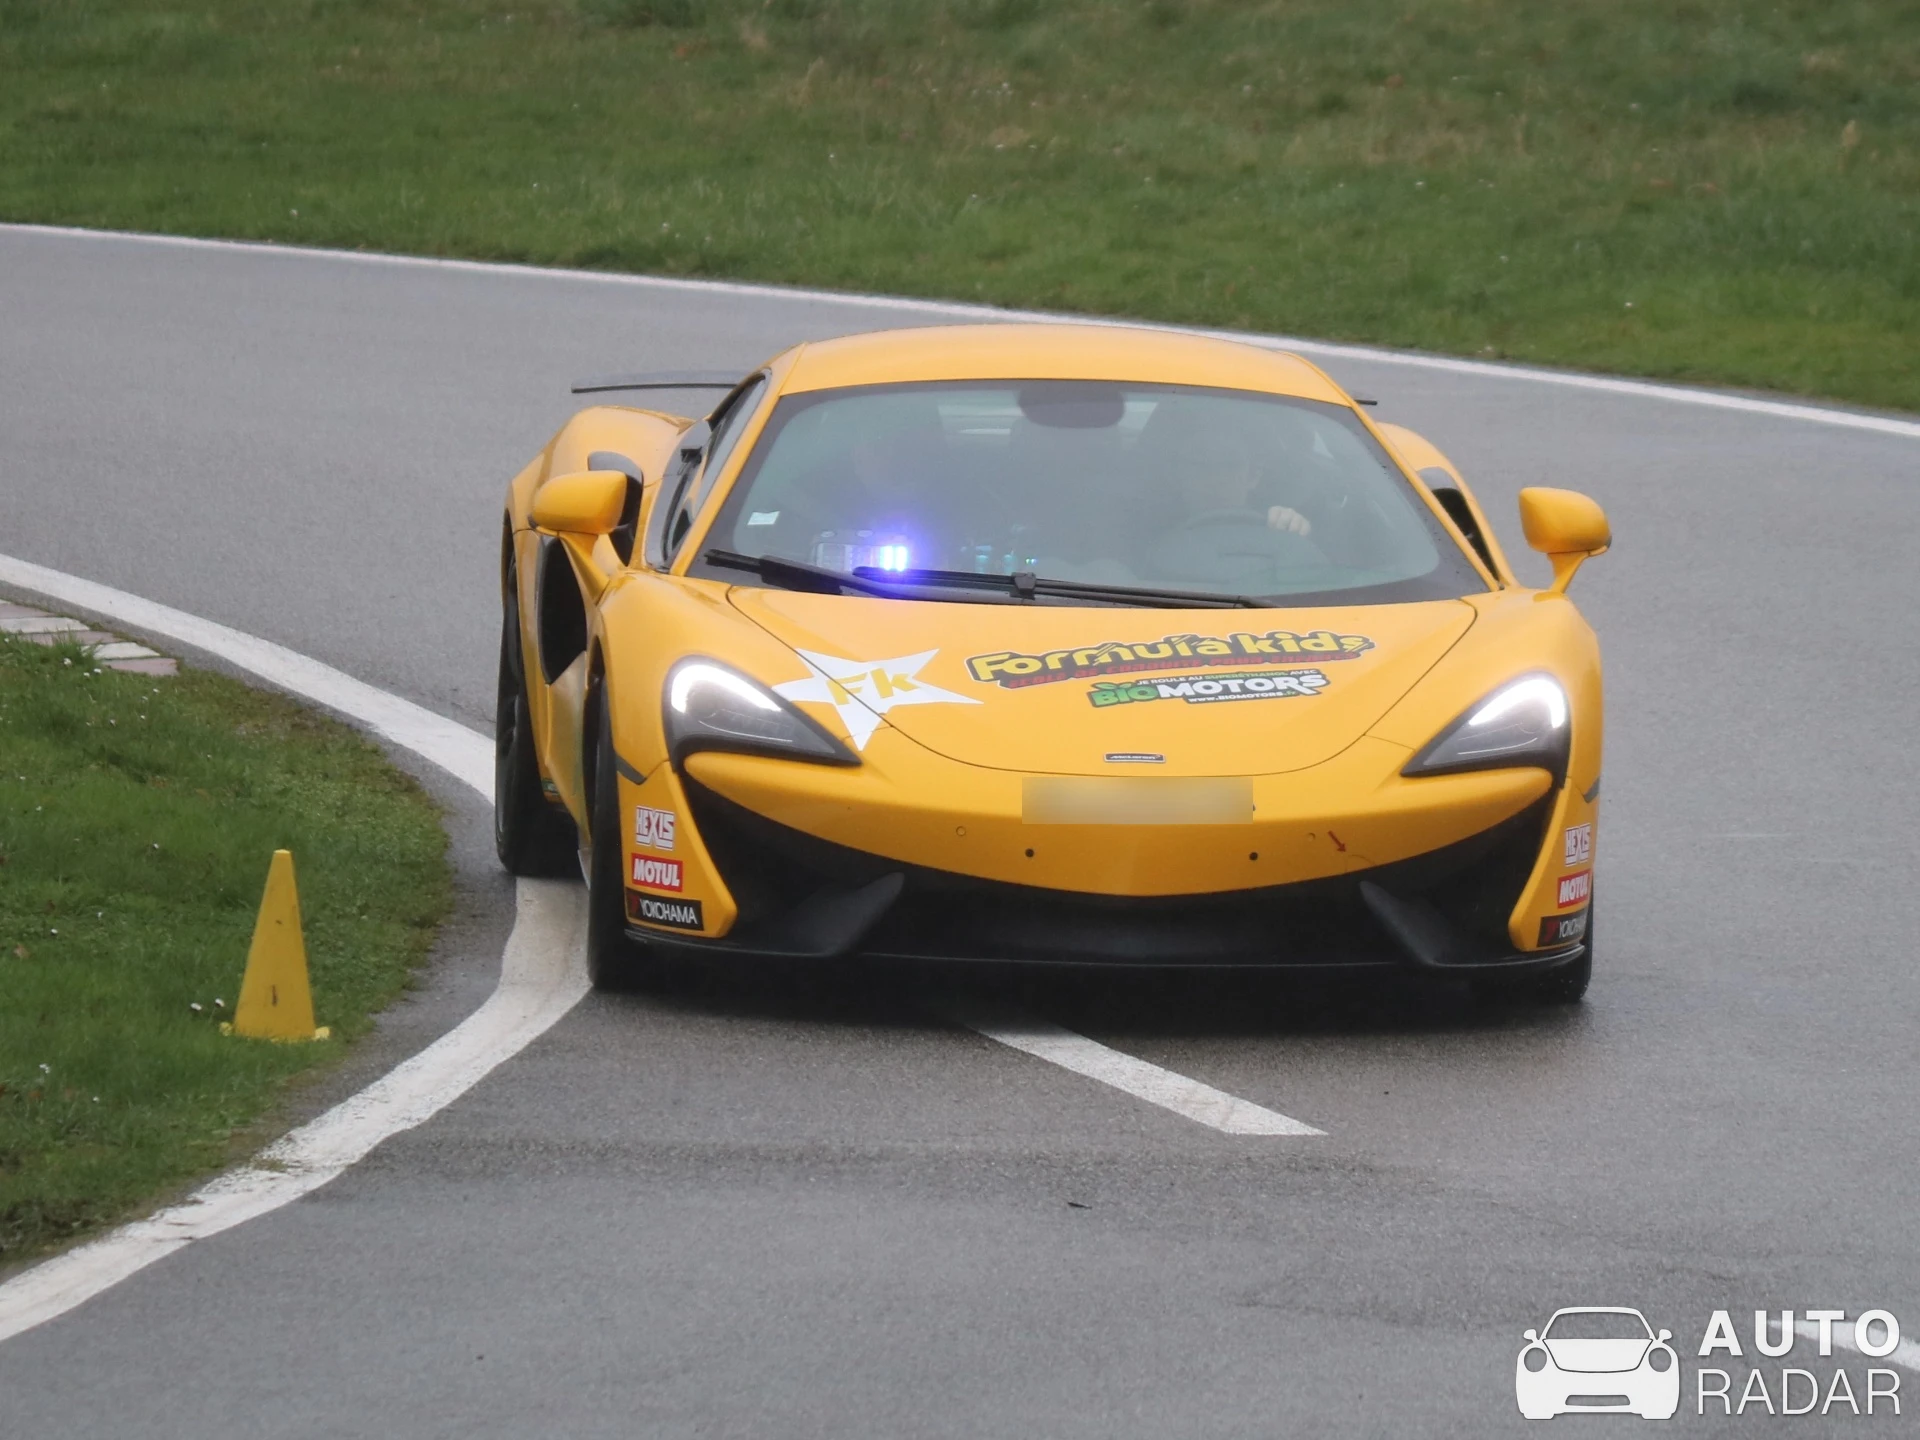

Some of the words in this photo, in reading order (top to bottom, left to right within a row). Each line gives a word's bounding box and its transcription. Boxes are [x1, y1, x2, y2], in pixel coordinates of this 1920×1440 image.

[972, 635, 1231, 680] Formula
[1236, 633, 1368, 653] kids
[1151, 676, 1186, 684] ROULE
[636, 807, 675, 848] HEXIS
[1565, 825, 1591, 865] HEXIS
[633, 858, 680, 887] MOTUL
[1559, 873, 1589, 903] MOTUL
[639, 898, 698, 925] YOKOHAMA
